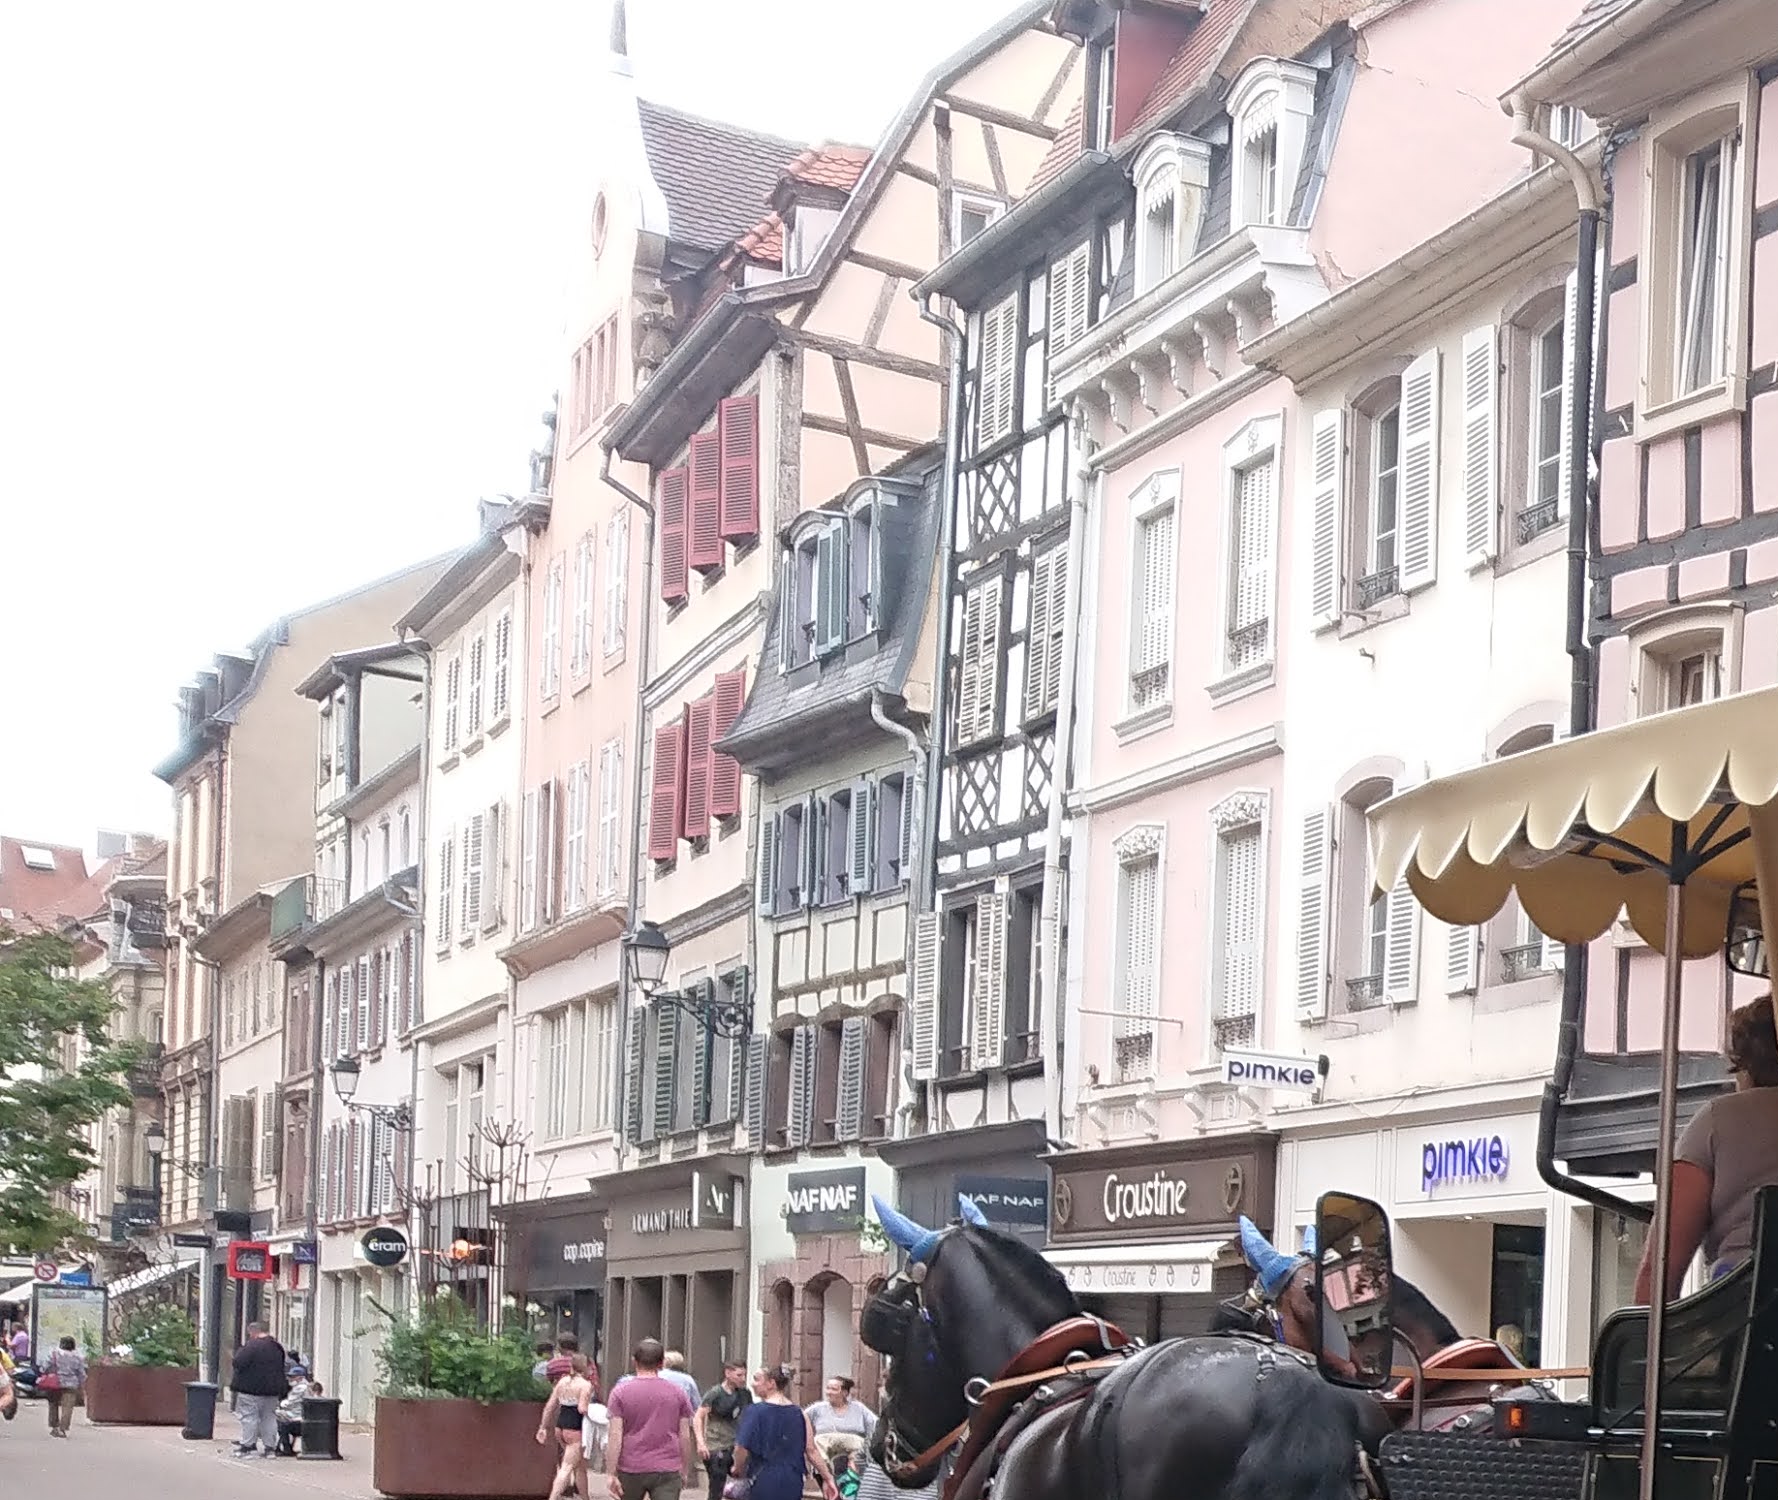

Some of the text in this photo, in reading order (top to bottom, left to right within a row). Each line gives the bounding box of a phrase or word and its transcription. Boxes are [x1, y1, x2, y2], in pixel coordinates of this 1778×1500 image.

[1228, 1060, 1315, 1085] pimkie
[1421, 1135, 1505, 1193] pimkie
[1003, 1195, 1045, 1207] NAF
[1103, 1169, 1187, 1222] Croustine
[668, 1207, 691, 1229] THIE
